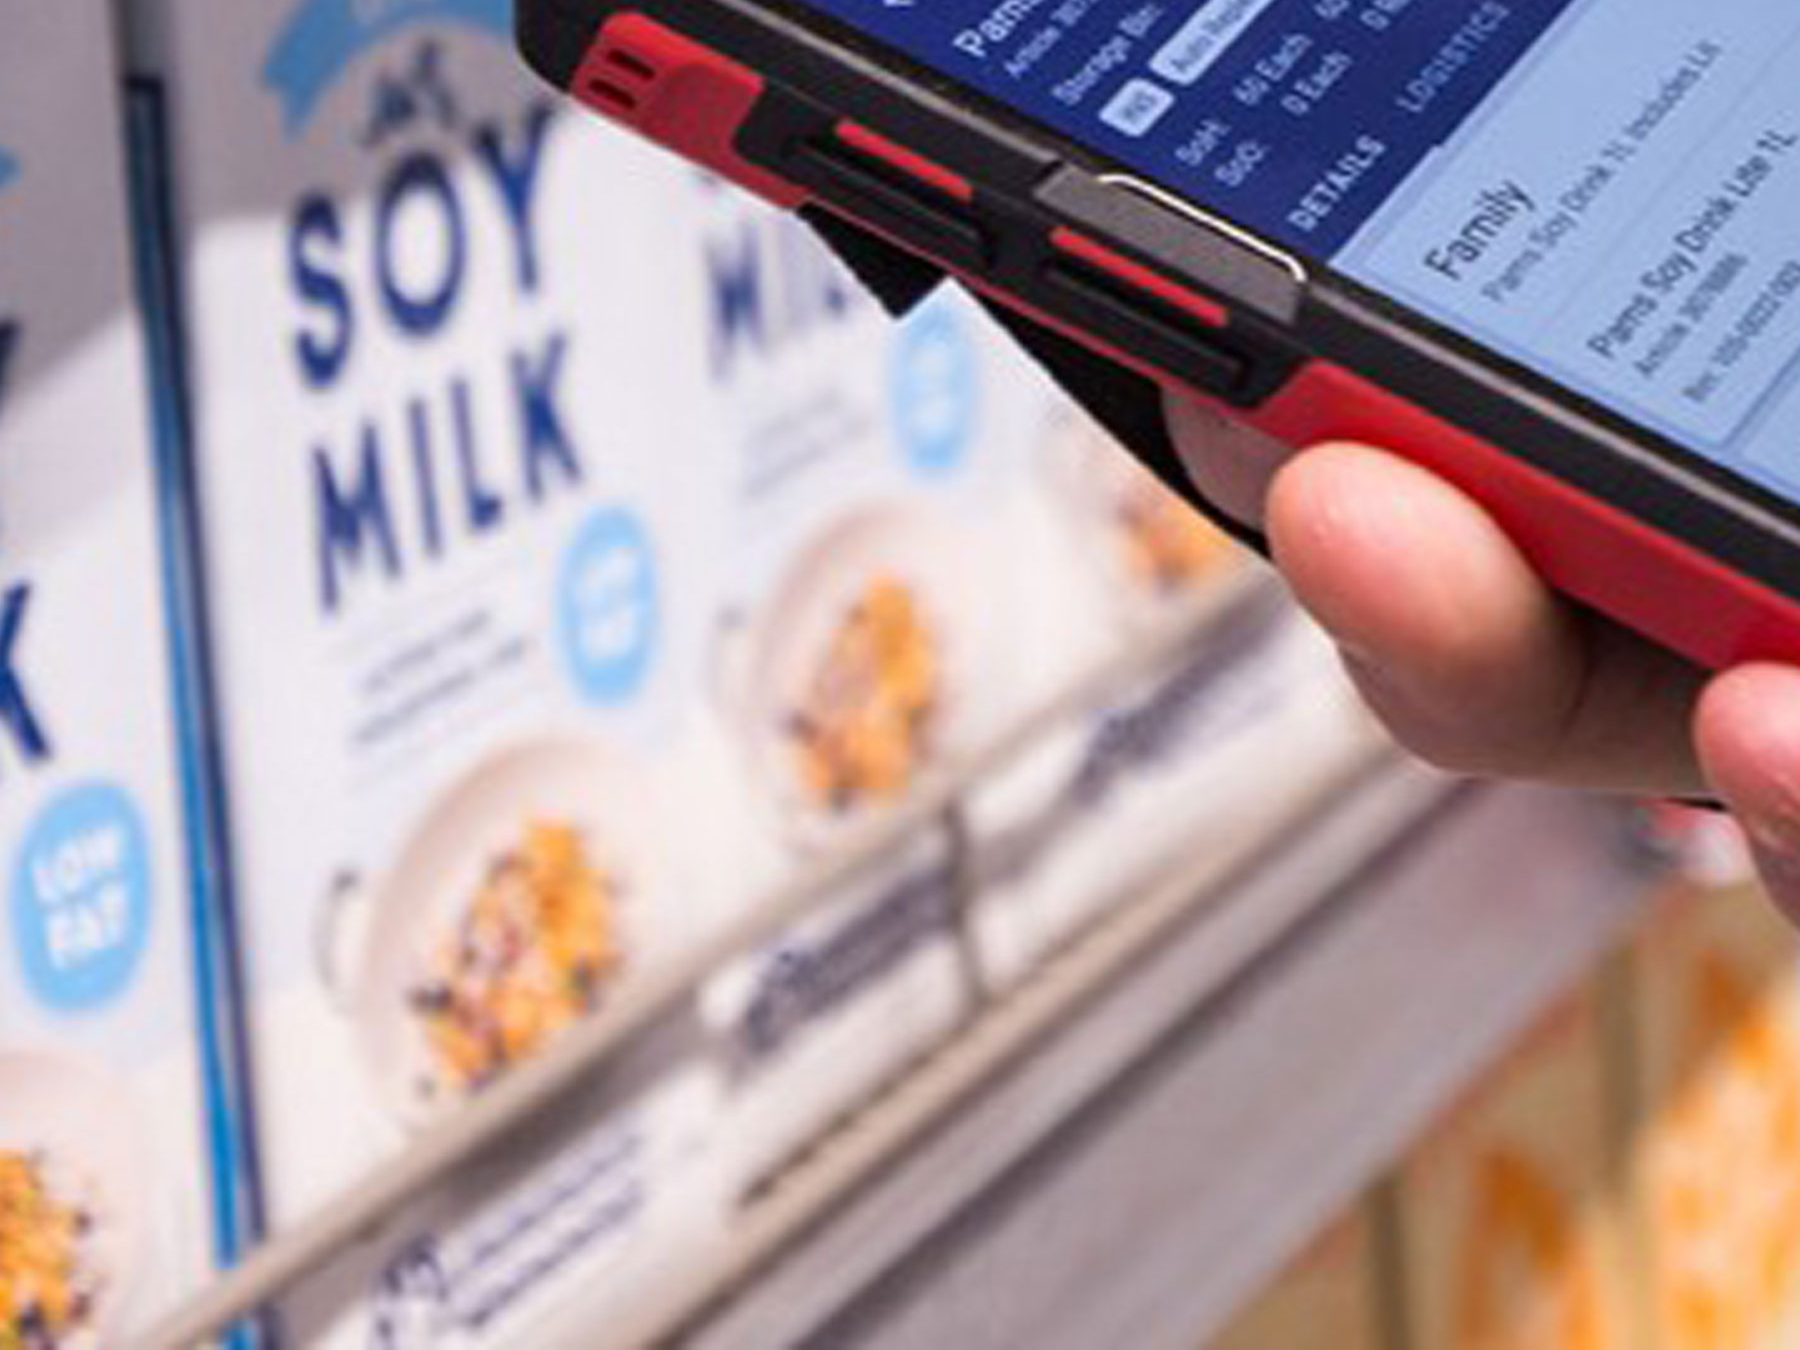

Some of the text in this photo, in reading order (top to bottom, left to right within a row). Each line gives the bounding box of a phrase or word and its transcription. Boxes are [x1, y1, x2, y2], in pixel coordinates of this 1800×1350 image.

[1003, 25, 1060, 77] Article
[1051, 35, 1130, 104] Storage
[1168, 34, 1214, 74] Auto
[1254, 33, 1311, 81] Each
[1293, 52, 1350, 99] Each
[1396, 0, 1509, 112] LOGISTICS
[1287, 135, 1384, 230] DETAILS
[1480, 248, 1543, 302] Pams
[1527, 210, 1578, 249] Soy
[1558, 164, 1614, 213] Drink
[1623, 66, 1701, 140] Includes
[288, 94, 556, 388] SOY
[1423, 182, 1534, 279] Family
[1586, 129, 1798, 359] Pams Soy Drink Lite 1L
[1633, 322, 1690, 378] Article
[313, 332, 583, 613] MILK
